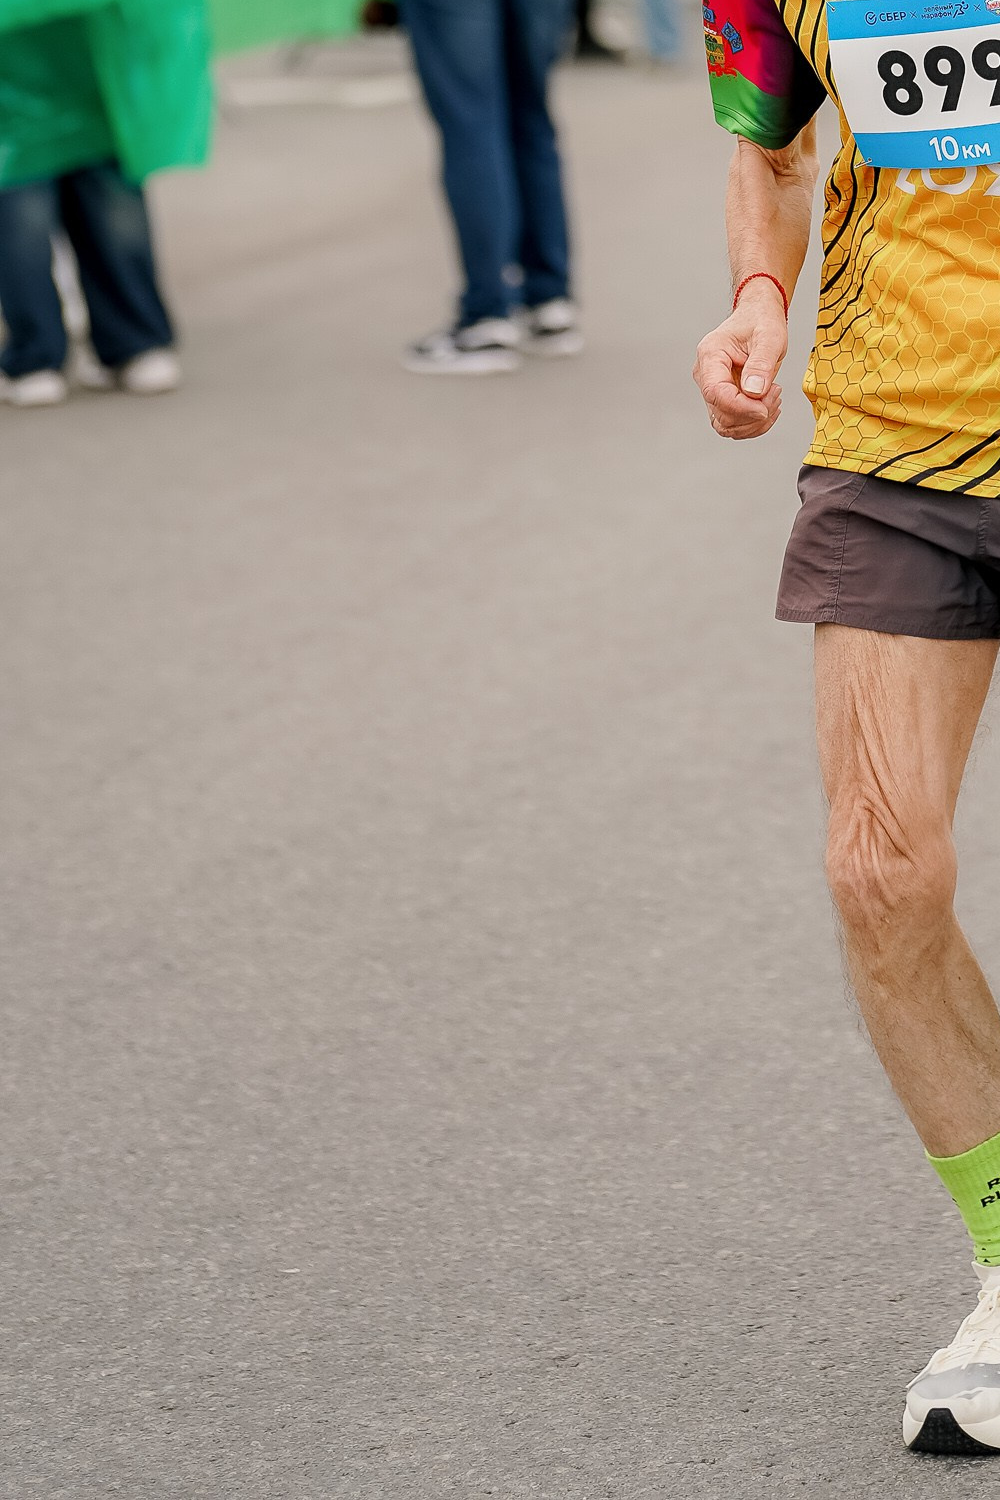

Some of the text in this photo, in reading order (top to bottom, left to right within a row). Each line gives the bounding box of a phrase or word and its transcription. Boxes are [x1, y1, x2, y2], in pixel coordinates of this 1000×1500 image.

[923, 2, 954, 12] зелёный
[879, 11, 907, 22] СБЕР
[921, 11, 953, 20] марафон
[929, 136, 960, 162] 10
